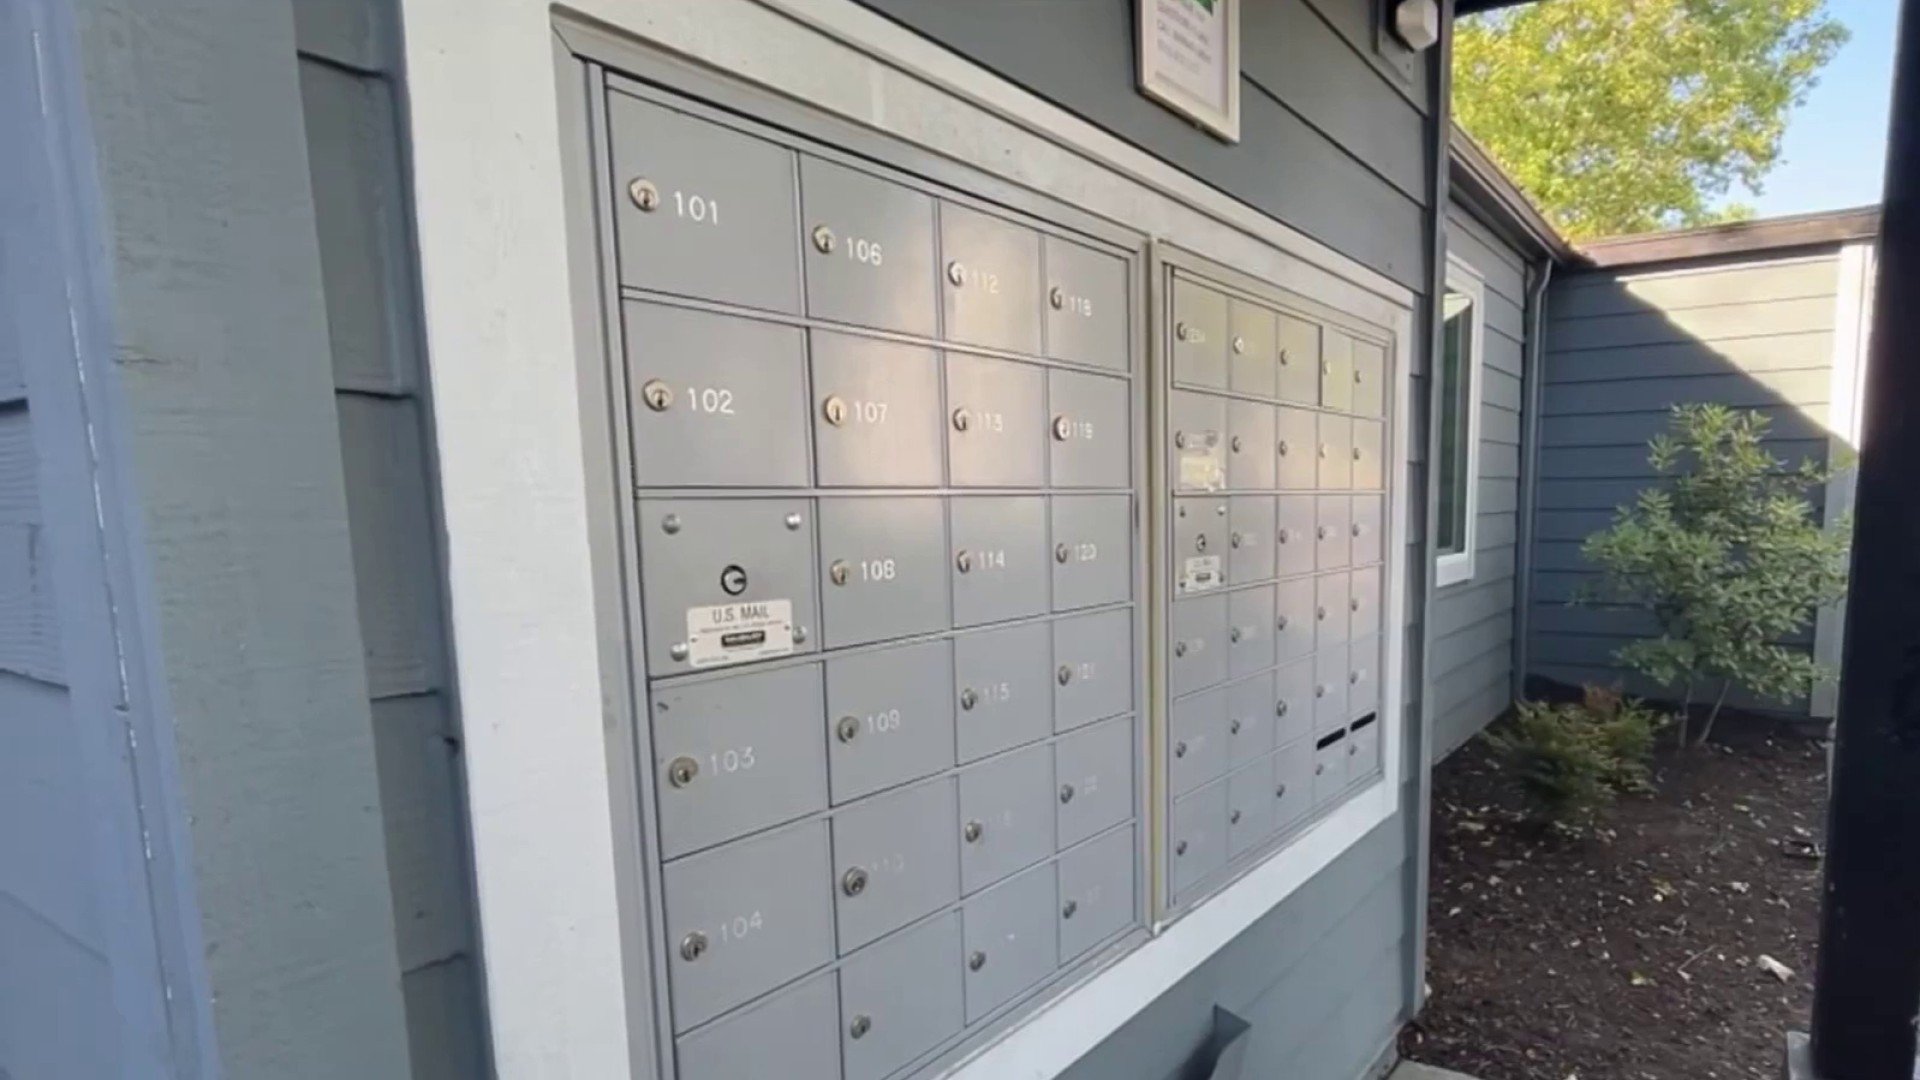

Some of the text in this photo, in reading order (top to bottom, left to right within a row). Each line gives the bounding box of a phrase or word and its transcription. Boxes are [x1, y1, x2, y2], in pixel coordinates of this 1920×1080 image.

[674, 191, 718, 226] 101
[847, 237, 883, 266] 106
[687, 387, 735, 414] 102
[854, 400, 888, 423] 107
[862, 559, 895, 582] 108
[979, 549, 1005, 571] 114
[740, 604, 769, 620] MAIL
[984, 682, 1010, 704] 115
[867, 709, 900, 736] 109
[711, 746, 755, 777] 103
[721, 910, 763, 944] 104
